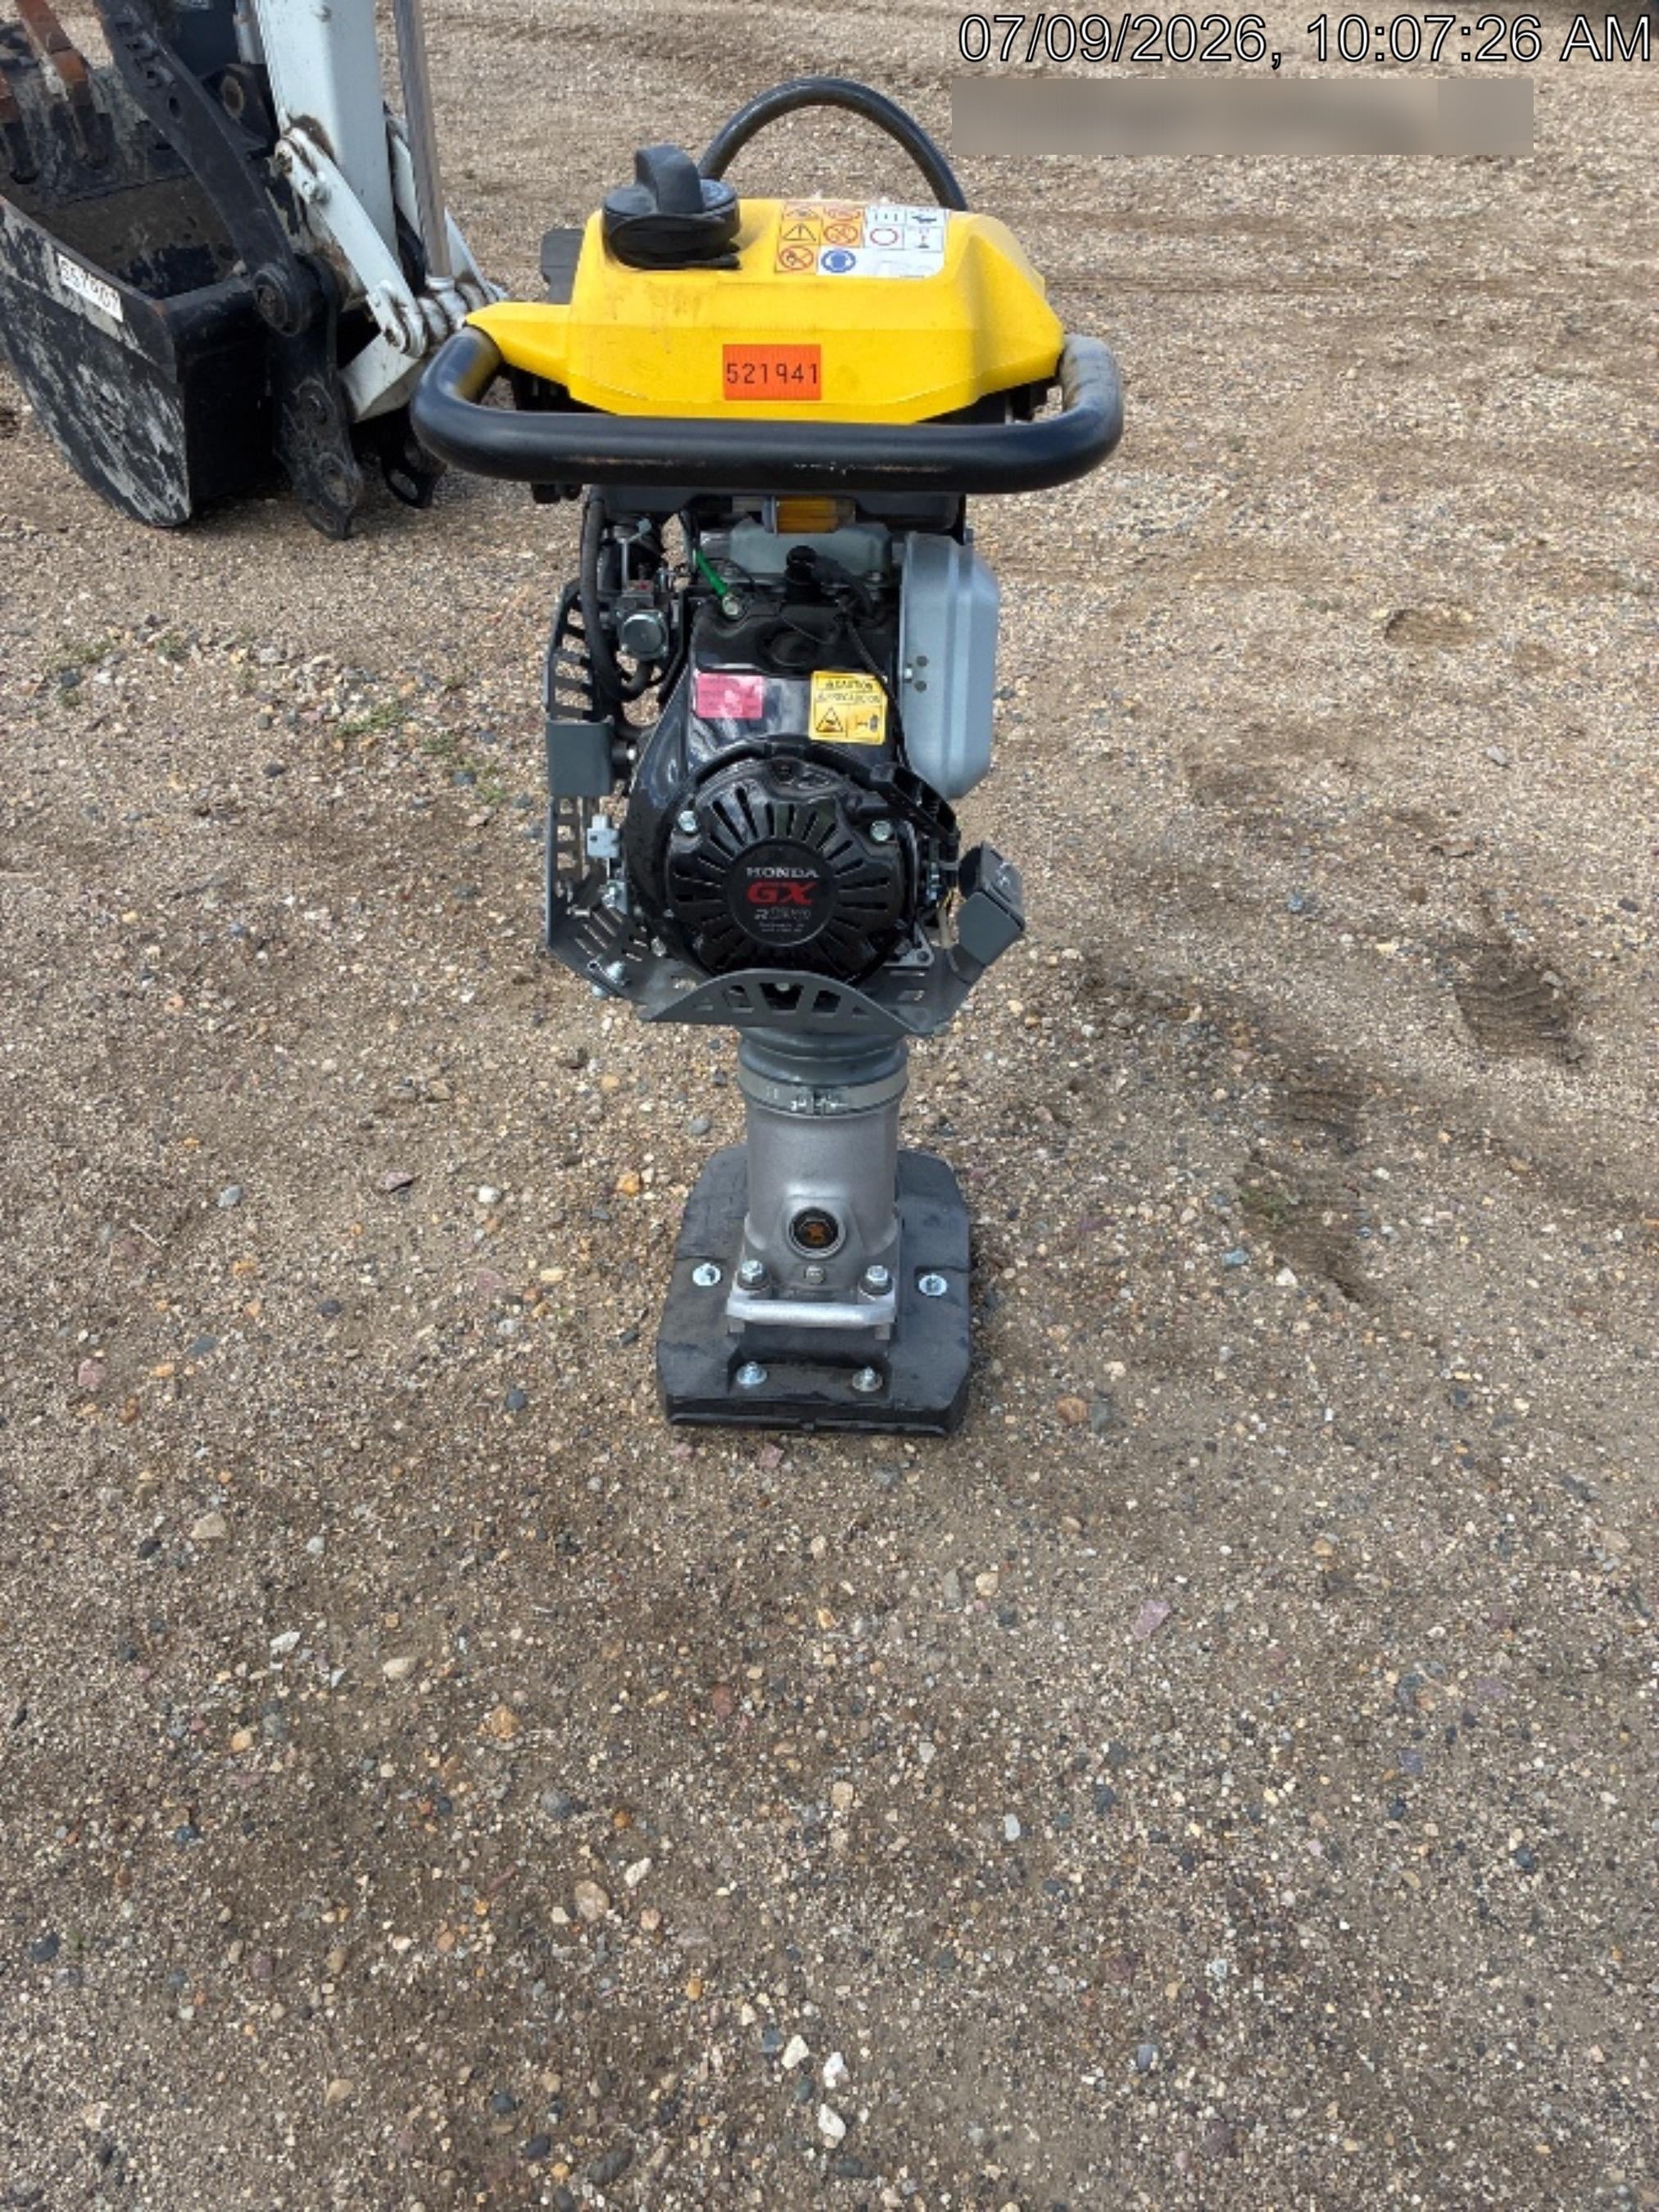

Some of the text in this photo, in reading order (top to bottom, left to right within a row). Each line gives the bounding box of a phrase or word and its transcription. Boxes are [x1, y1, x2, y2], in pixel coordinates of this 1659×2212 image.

[726, 363, 818, 384] 521941
[746, 867, 819, 878] HONDA
[746, 881, 817, 905] GX
